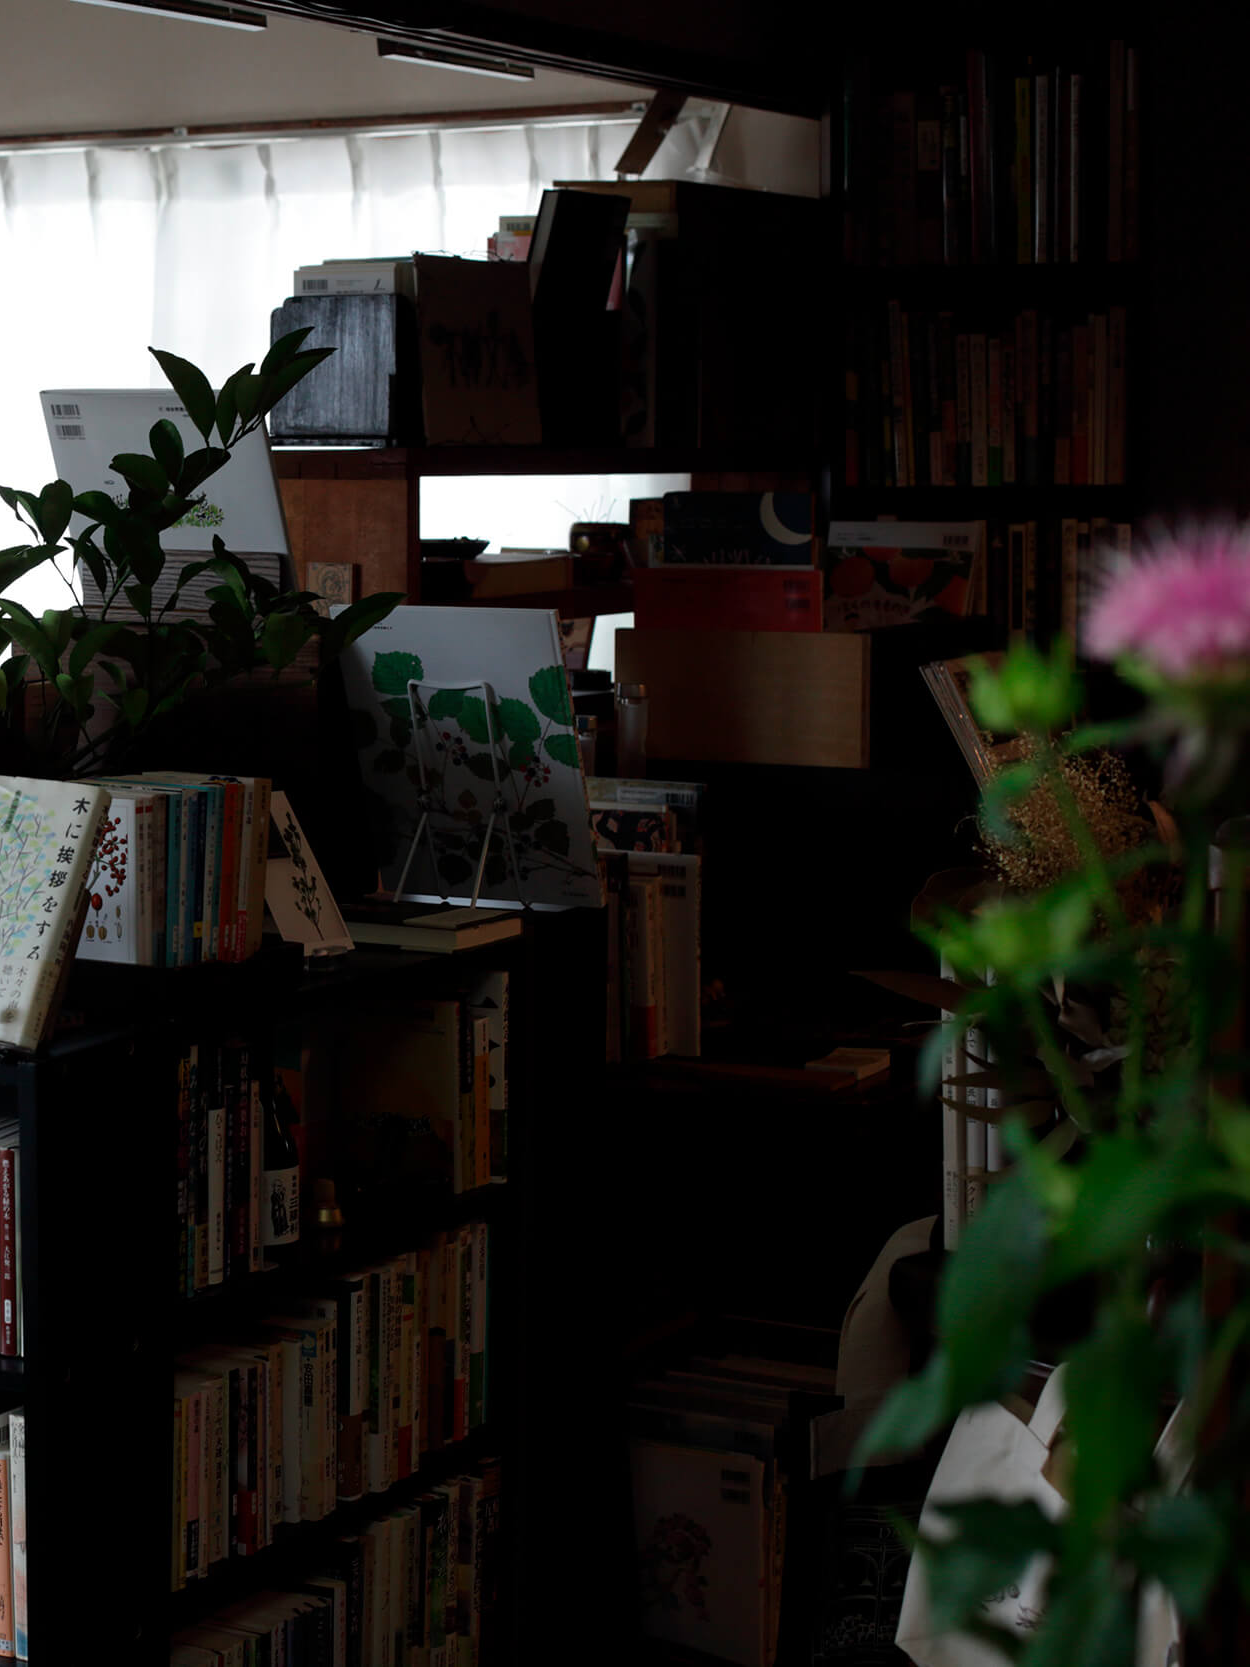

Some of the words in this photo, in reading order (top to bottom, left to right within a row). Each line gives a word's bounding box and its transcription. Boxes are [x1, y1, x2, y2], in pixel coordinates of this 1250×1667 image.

[26, 798, 91, 960] 木に挨拶をする
